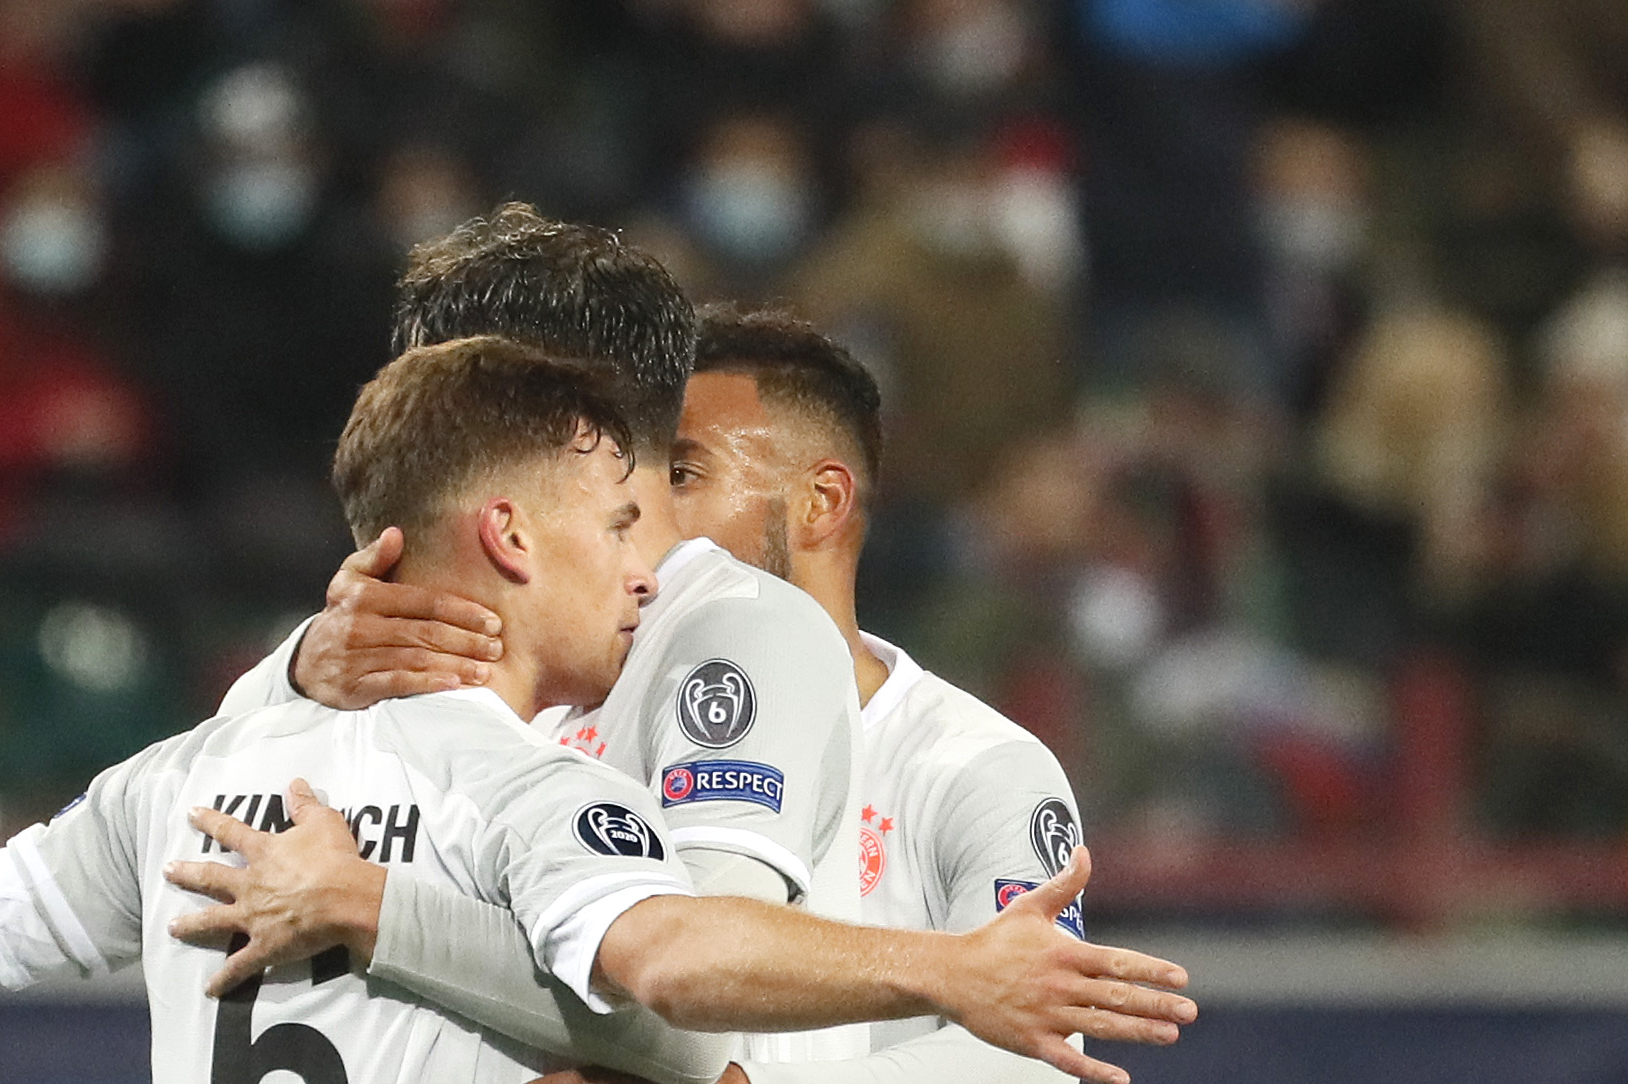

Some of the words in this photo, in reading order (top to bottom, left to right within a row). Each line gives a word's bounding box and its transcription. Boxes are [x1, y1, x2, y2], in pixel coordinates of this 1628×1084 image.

[708, 701, 727, 723] 6
[697, 771, 782, 801] RESPECT
[201, 794, 422, 863] KICH
[609, 829, 638, 843] 2020
[1058, 842, 1070, 866] 6
